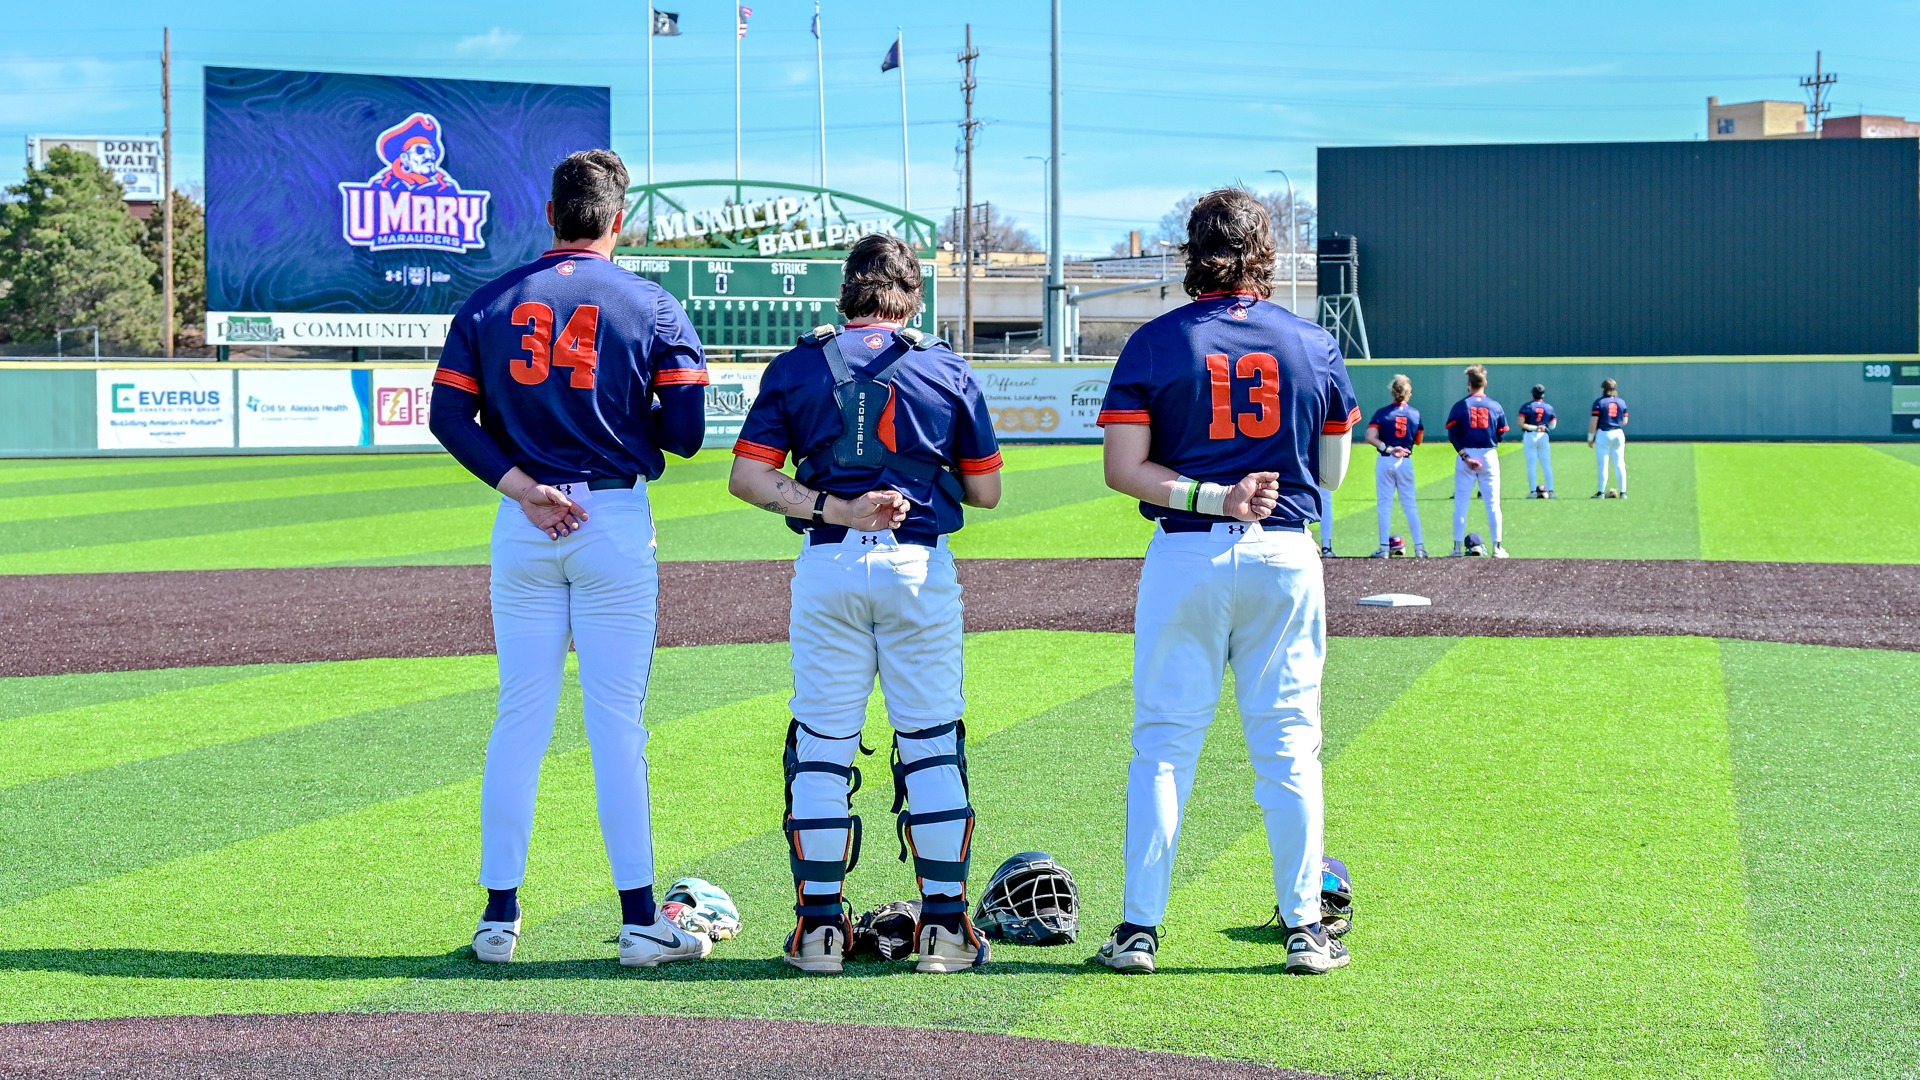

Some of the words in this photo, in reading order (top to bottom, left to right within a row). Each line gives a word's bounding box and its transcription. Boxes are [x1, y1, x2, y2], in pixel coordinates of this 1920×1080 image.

[104, 141, 155, 152] DONT
[105, 154, 156, 166] WAIT
[652, 191, 841, 242] MUNICIPAL
[377, 233, 461, 247] MARAUDERS
[756, 216, 899, 257] BALLPARK
[641, 260, 670, 273] PITCHES
[707, 261, 735, 274] BALL
[770, 262, 808, 275] STRIKE
[715, 273, 728, 294] 0
[783, 274, 796, 295] 0
[693, 300, 702, 311] 2
[708, 300, 717, 311] 3
[724, 300, 733, 311] 4
[738, 300, 747, 311] 5
[751, 300, 760, 311] 6
[768, 300, 777, 311] 7
[781, 300, 790, 311] 8
[795, 300, 803, 311] 9
[808, 300, 822, 312] 10
[293, 321, 431, 338] COMMUNITY
[510, 301, 600, 390] 34
[1865, 364, 1891, 378] 380
[986, 373, 1038, 391] Different
[139, 390, 220, 405] EVERUS
[1205, 352, 1281, 440] 13
[290, 404, 320, 412] Alexius
[322, 404, 348, 412] Health
[1535, 407, 1545, 422] 7
[856, 392, 866, 456] EVOSHIELD
[1395, 416, 1408, 438] 5
[1133, 941, 1150, 951] NIKE
[1291, 941, 1307, 951] NIKE
